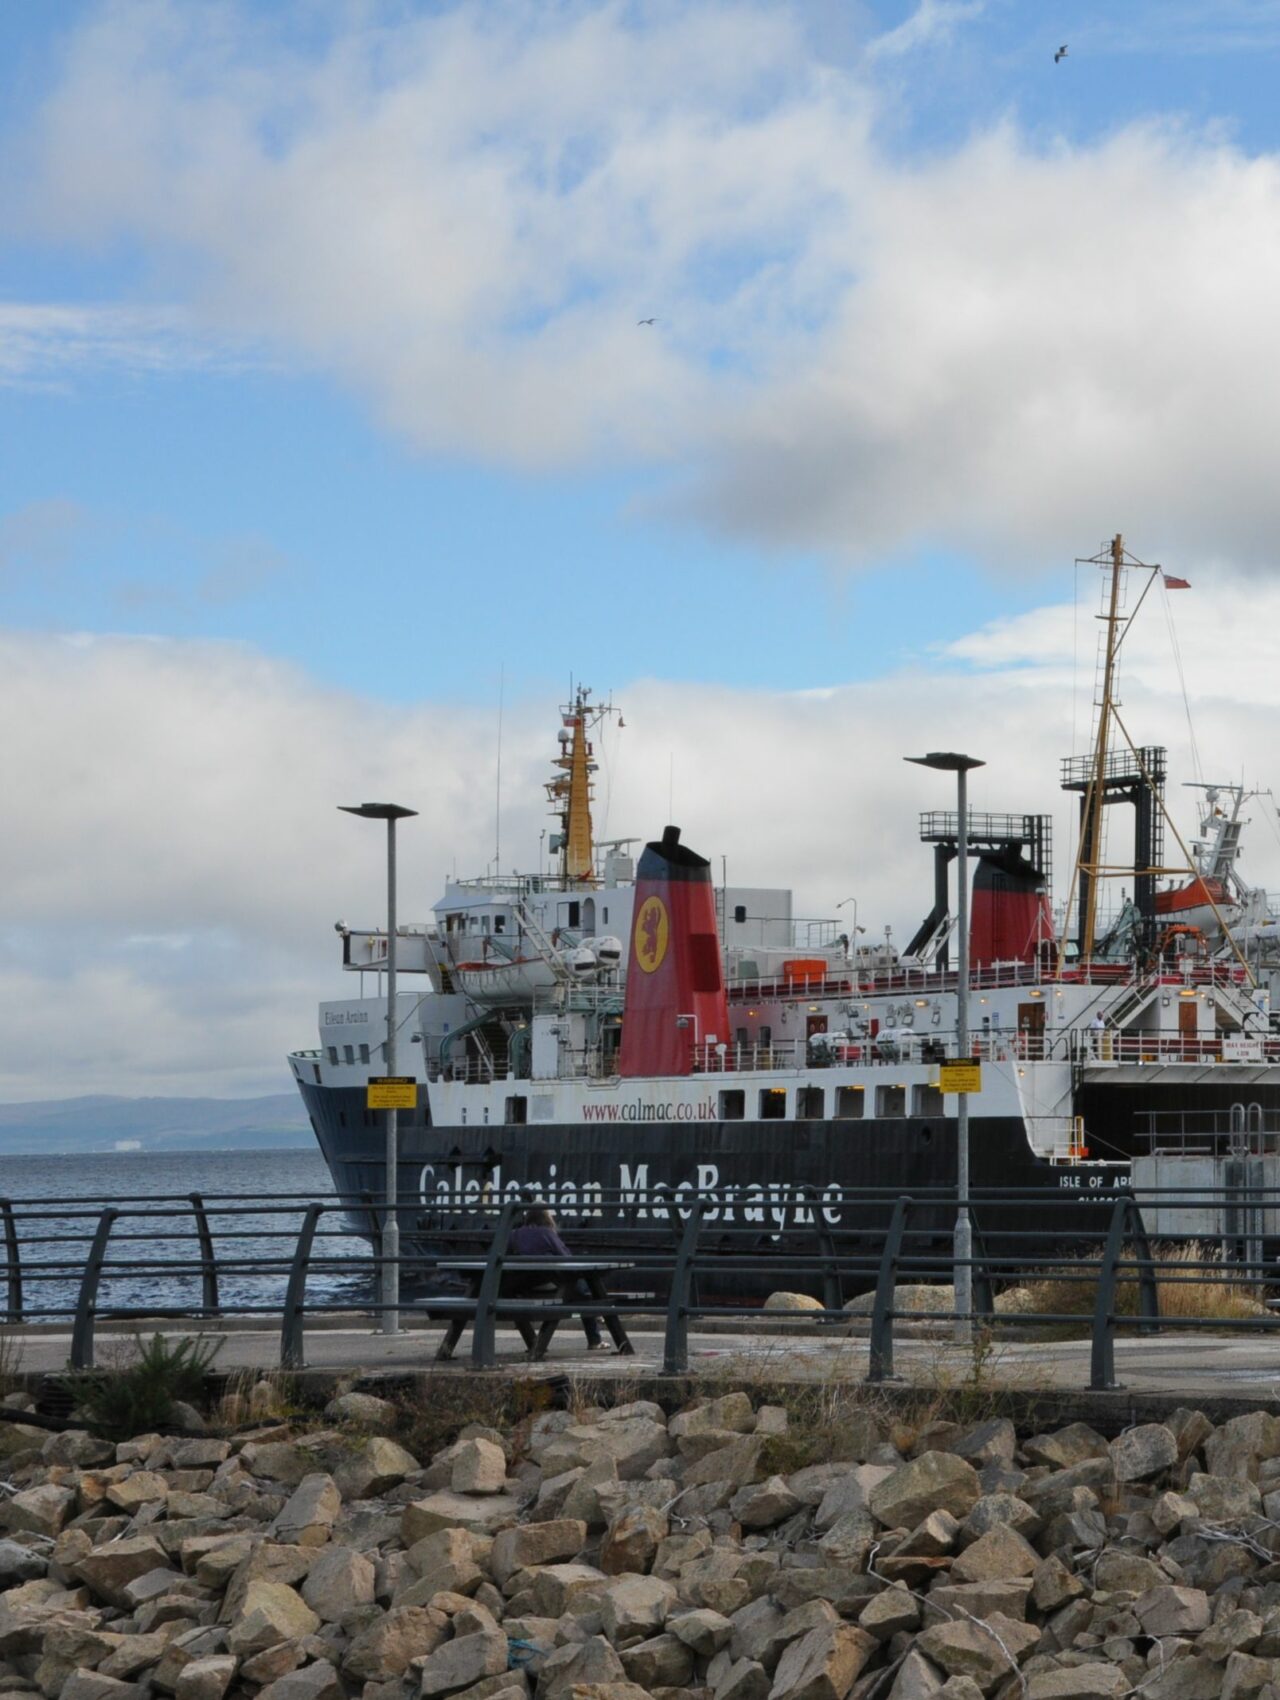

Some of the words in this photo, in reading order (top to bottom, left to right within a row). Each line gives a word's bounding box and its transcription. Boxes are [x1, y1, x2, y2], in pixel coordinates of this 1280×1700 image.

[583, 1096, 716, 1121] www.calmac.co.uk
[1060, 1176, 1080, 1187] ISLE
[1089, 1176, 1103, 1188] OF
[617, 1164, 844, 1241] MacBrayne
